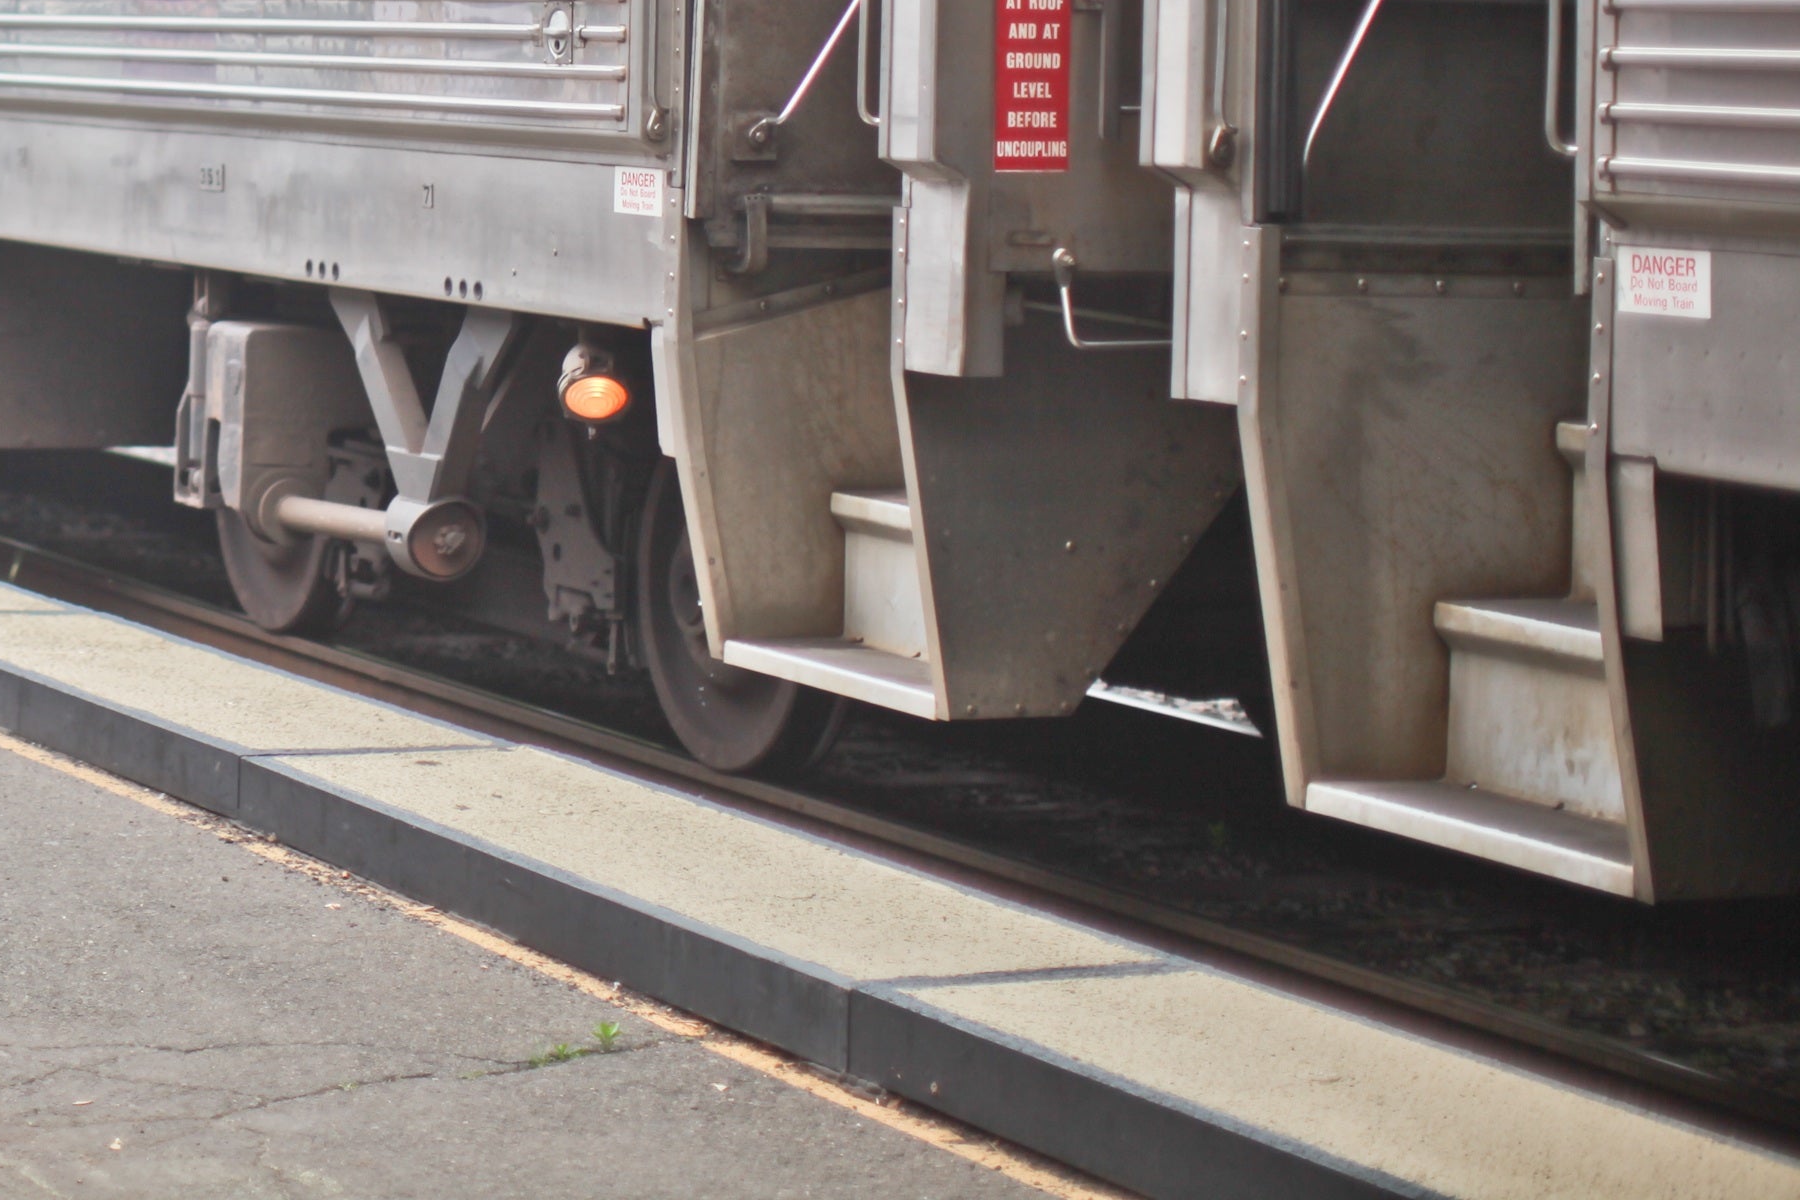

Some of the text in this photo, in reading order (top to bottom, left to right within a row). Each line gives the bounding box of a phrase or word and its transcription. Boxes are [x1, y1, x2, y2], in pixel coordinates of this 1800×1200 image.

[1009, 23, 1059, 39] AND AT
[1006, 52, 1060, 69] GROUND
[1013, 82, 1051, 98] LEVEL
[1008, 111, 1056, 128] BEFORE
[997, 141, 1066, 158] UNCOUPLING
[622, 172, 656, 187] DANGER
[1632, 254, 1696, 277] DANGER
[1630, 277, 1697, 292] Do Not Board
[1634, 294, 1694, 310] Moving Train
